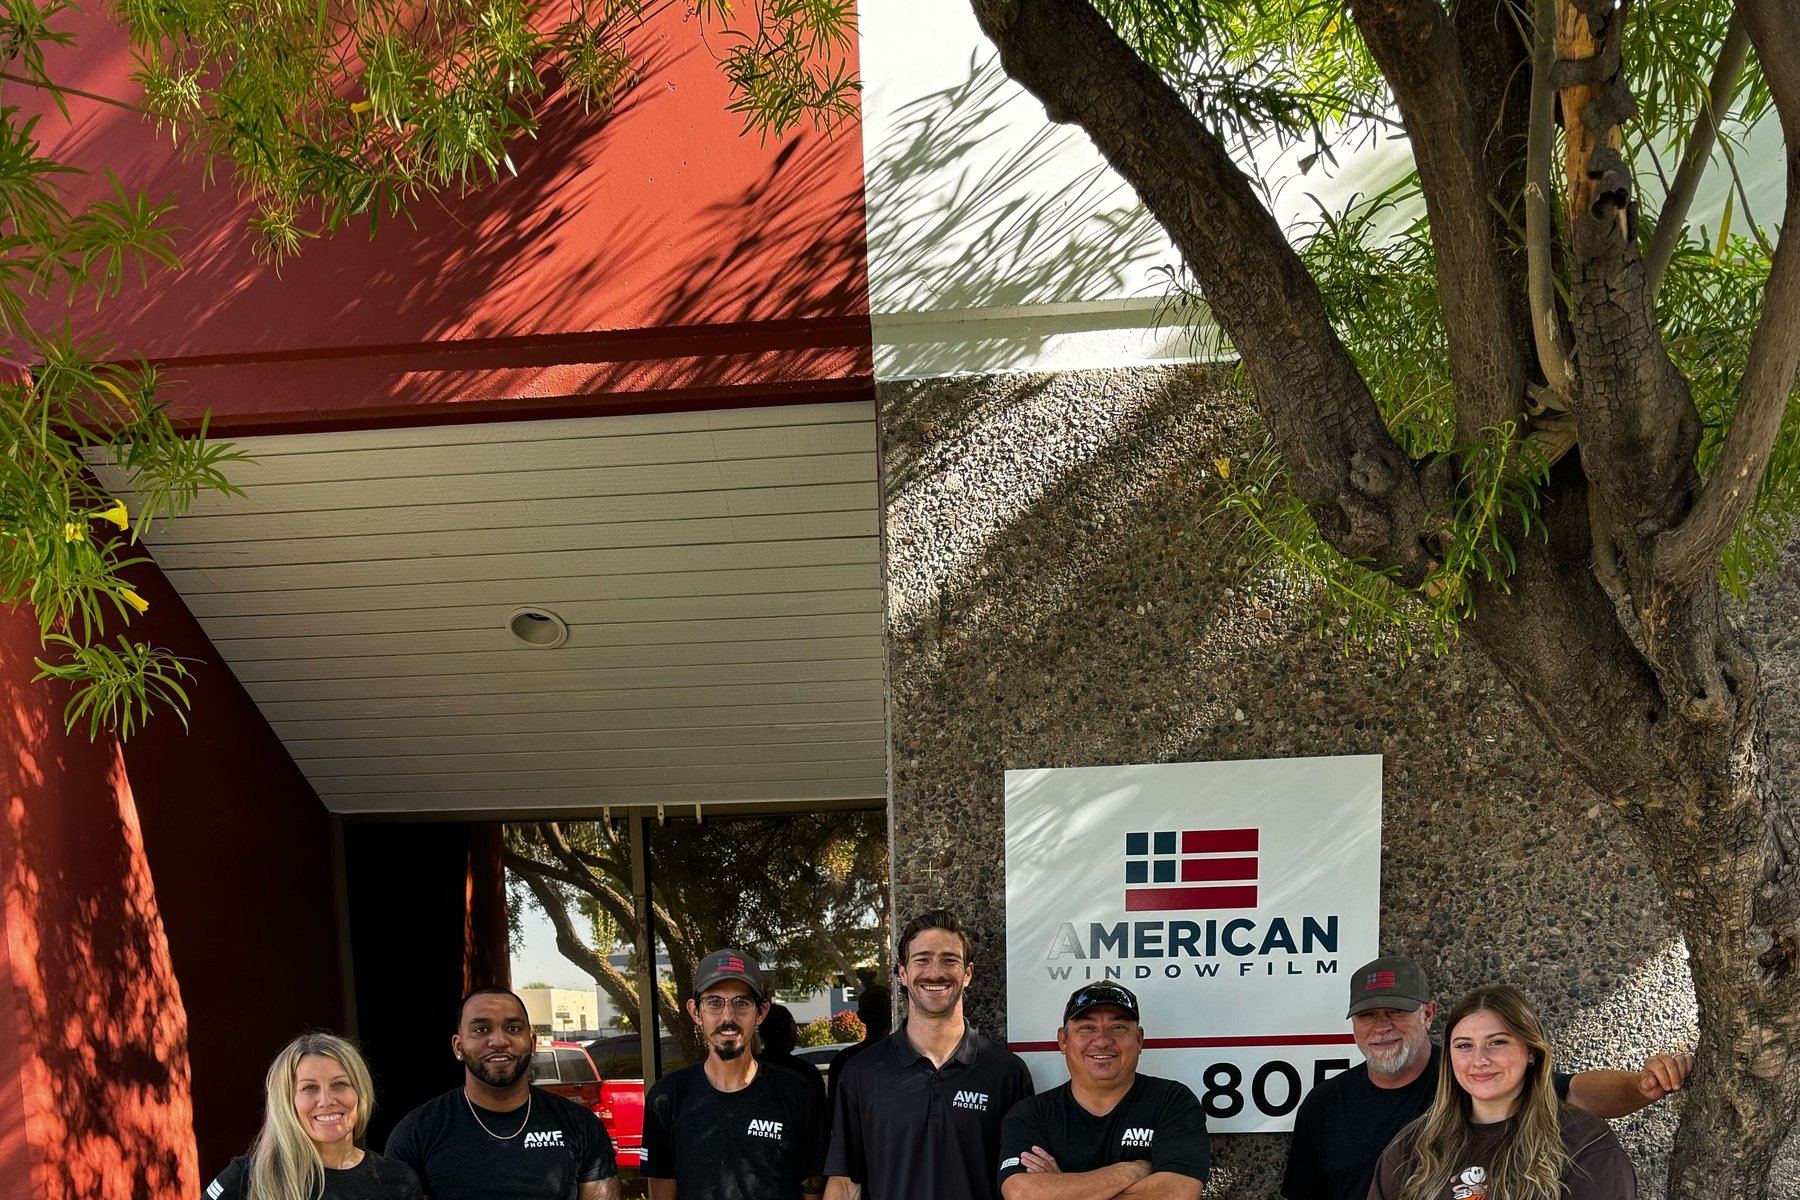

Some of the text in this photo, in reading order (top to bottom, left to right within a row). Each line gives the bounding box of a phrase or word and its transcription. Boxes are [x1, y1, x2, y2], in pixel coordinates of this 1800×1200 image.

[1046, 915, 1338, 960] AMERICAN
[1046, 959, 1338, 981] WINDOW FILM
[953, 1090, 988, 1104] AWF
[952, 1101, 988, 1111] PHOENIX
[748, 1119, 783, 1133] AWF
[524, 1130, 562, 1143] AWF
[747, 1130, 782, 1140] PHOENIX
[524, 1141, 565, 1149] PHOENIX
